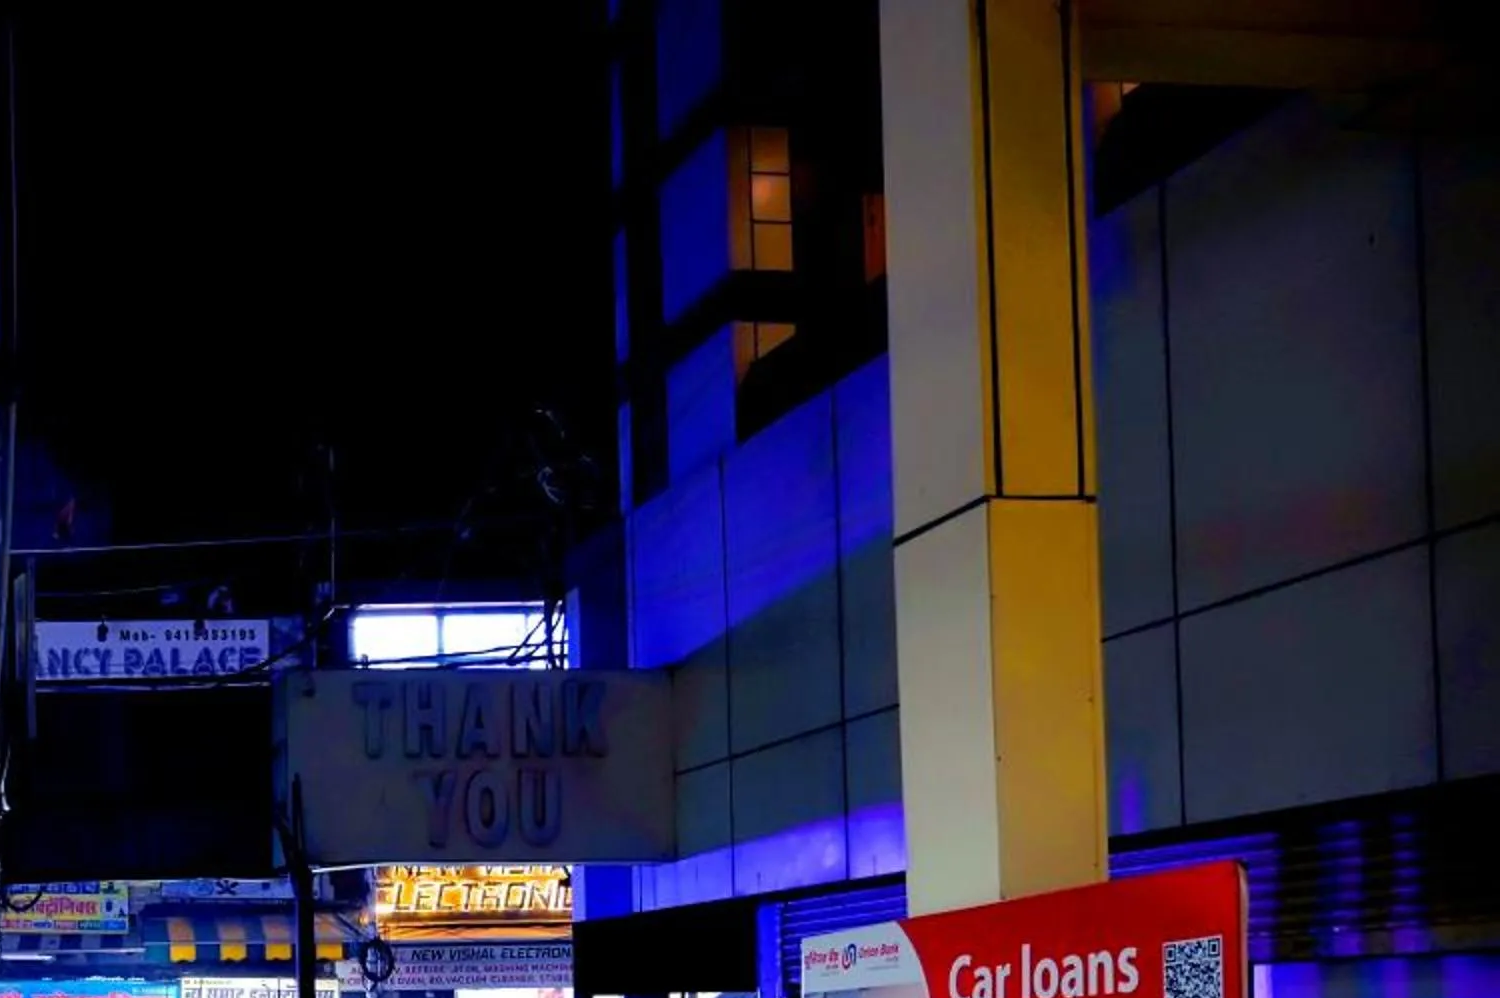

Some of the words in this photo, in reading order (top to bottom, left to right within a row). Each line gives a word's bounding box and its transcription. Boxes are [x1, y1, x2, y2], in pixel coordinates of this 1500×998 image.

[123, 647, 264, 677] PALACE
[351, 680, 607, 759] THANK
[410, 768, 563, 849] YOU
[411, 949, 444, 961] NEW
